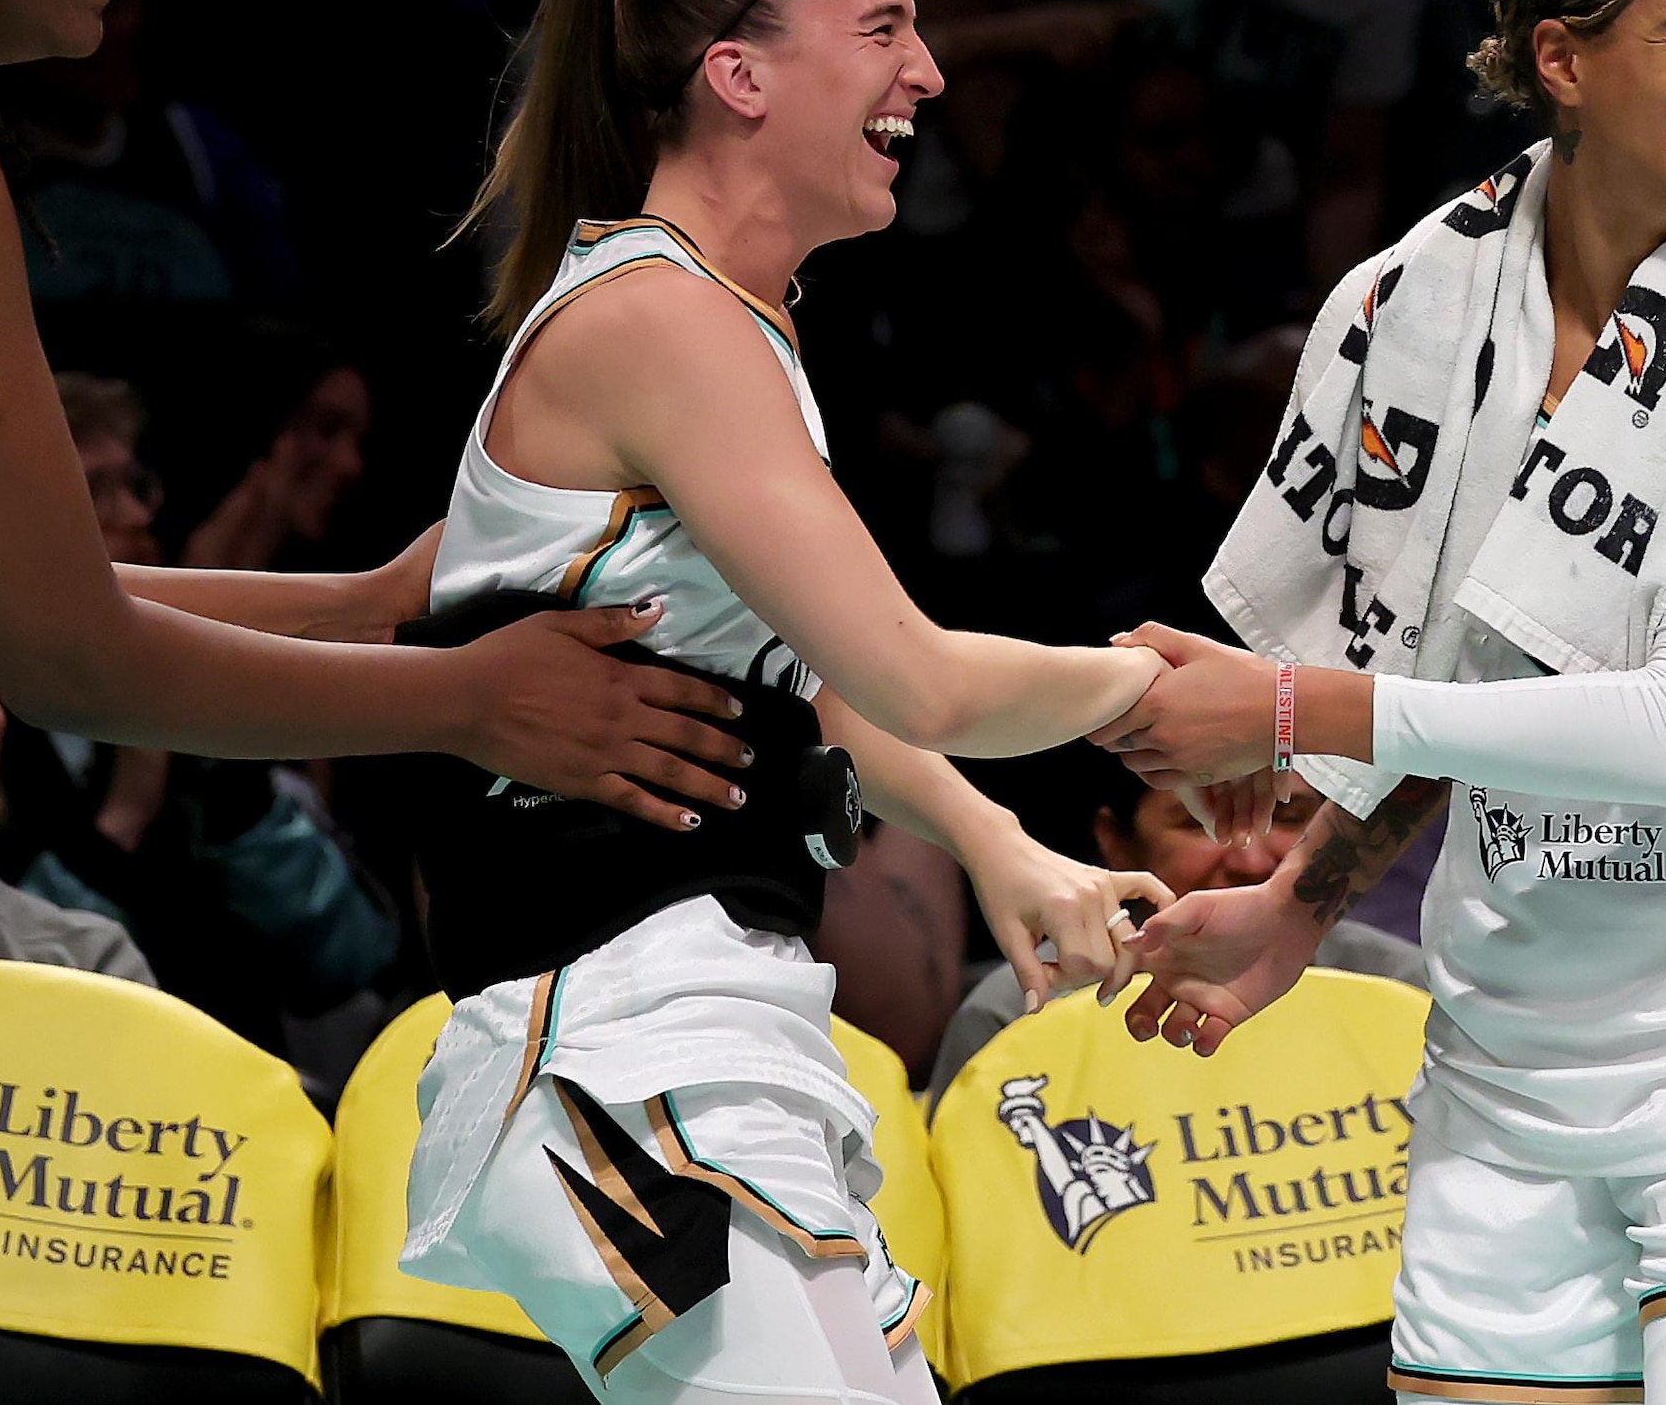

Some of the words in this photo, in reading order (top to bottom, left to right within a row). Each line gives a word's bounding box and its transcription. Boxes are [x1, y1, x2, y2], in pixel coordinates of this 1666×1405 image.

[1540, 813, 1663, 859] Liberty
[1536, 850, 1666, 882] Mutual
[1191, 1160, 1408, 1227] Mutua
[2, 1230, 232, 1279] INSURANCE
[1234, 1222, 1403, 1274] INSURAN
